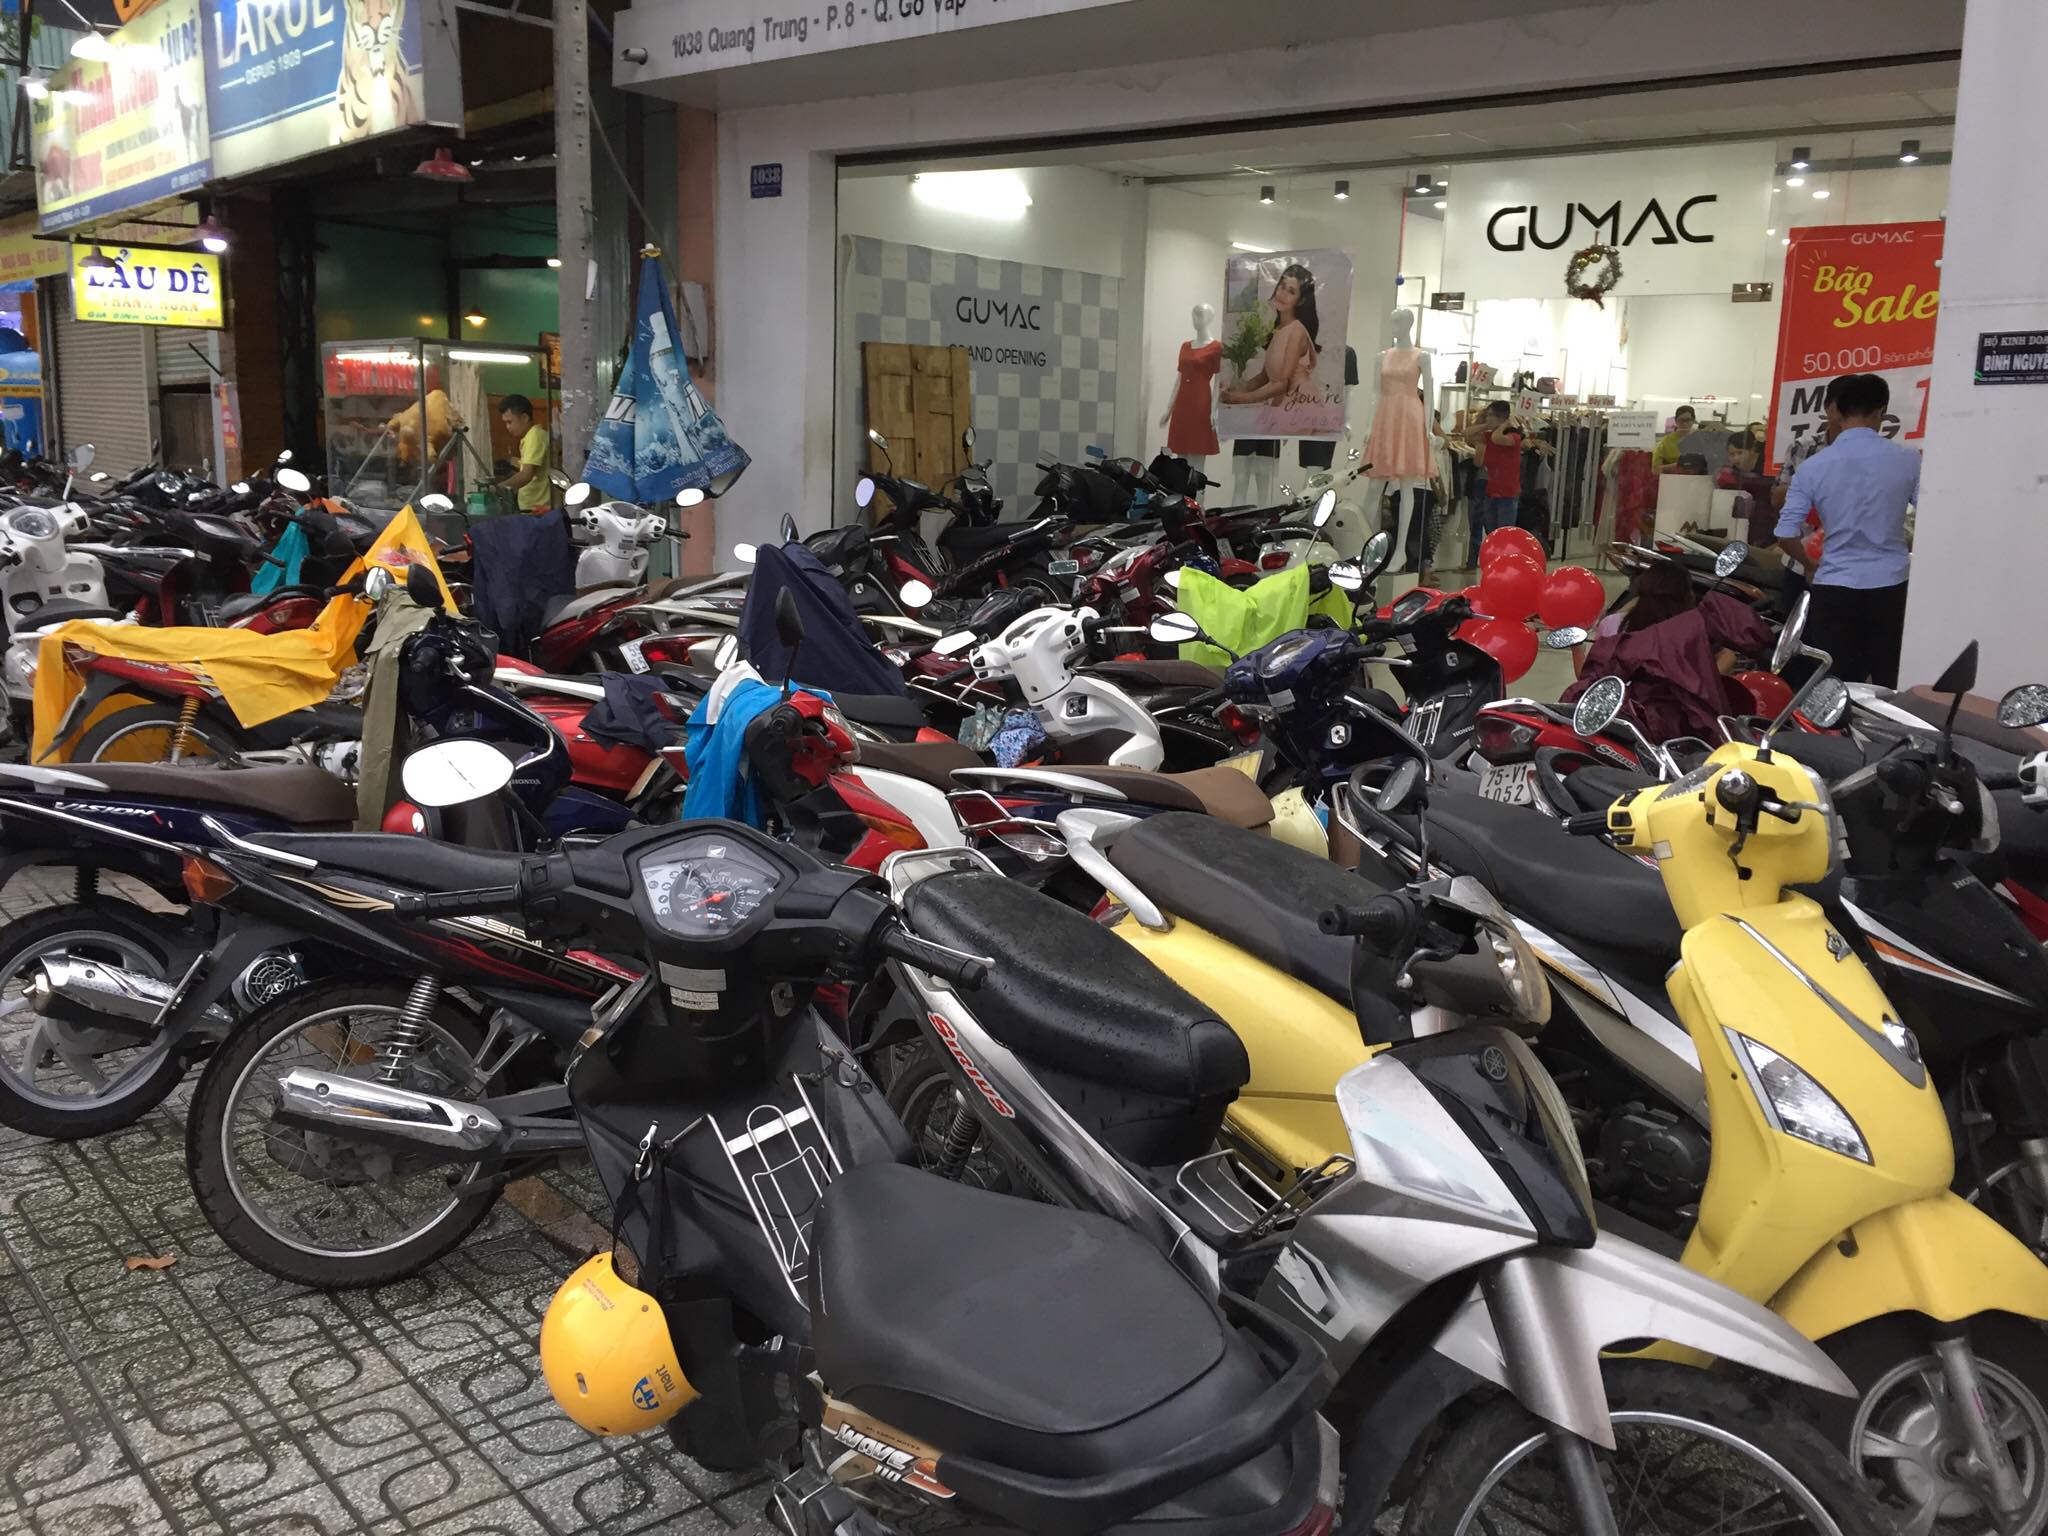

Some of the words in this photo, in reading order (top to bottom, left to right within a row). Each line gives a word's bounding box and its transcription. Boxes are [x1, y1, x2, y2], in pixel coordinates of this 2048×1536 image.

[672, 31, 703, 58] 1038
[708, 27, 755, 52] Quang
[763, 16, 808, 42] Trung
[752, 166, 781, 185] 1038
[1486, 193, 1718, 253] GUMAC
[1850, 230, 1915, 246] GUMAC
[167, 262, 210, 295] DÊ
[1813, 264, 1874, 294] Bão
[956, 295, 1041, 331] GUMAC
[1832, 283, 1940, 329] Sale
[949, 343, 993, 363] AND
[995, 347, 1047, 368] OPENING
[2000, 336, 2026, 346] KINH
[1802, 345, 1882, 374] 50.000
[1486, 764, 1528, 787] 75-V1
[1483, 784, 1525, 803] 1052
[54, 801, 156, 818] VISION
[656, 1363, 676, 1392] mart
